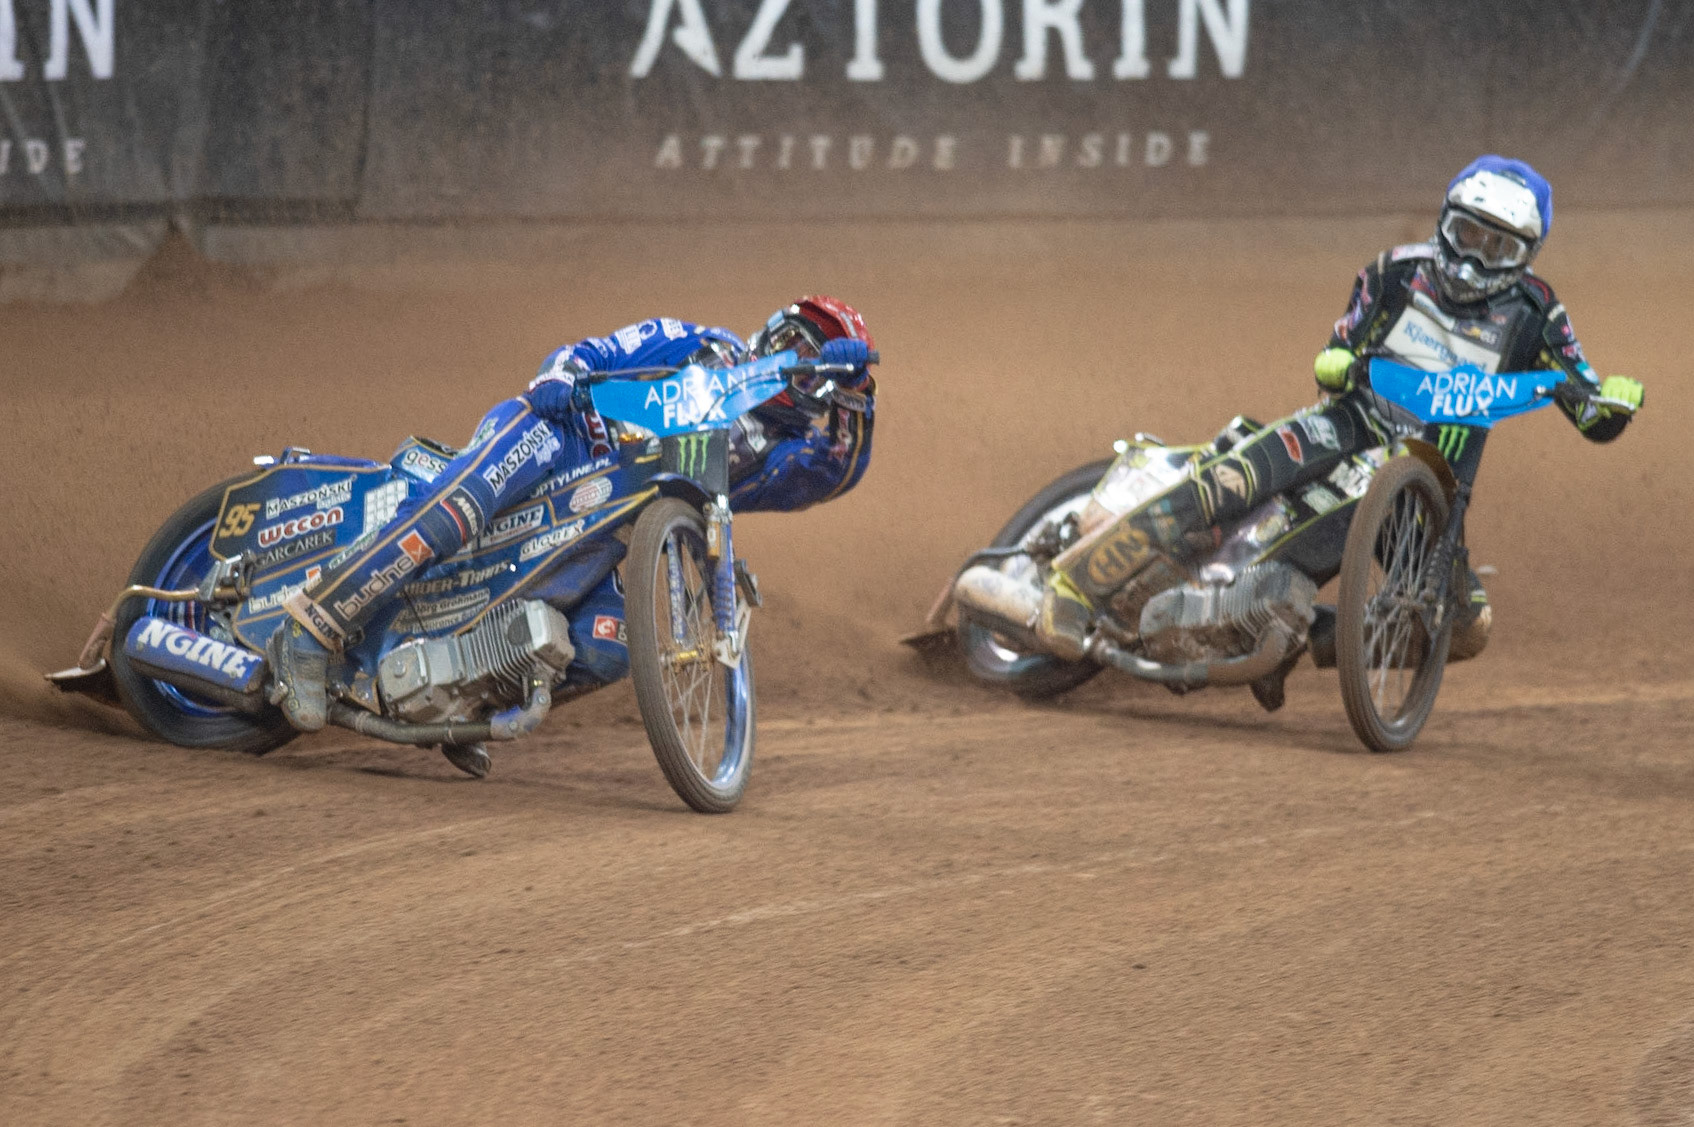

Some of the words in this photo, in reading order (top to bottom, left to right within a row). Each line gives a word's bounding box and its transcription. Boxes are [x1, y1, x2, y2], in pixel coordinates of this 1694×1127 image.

[655, 134, 957, 170] ATTITUDE
[1009, 131, 1211, 168] INSIDE
[644, 368, 747, 411] ADRAN
[1415, 371, 1518, 400] ADRIAN
[1430, 393, 1493, 418] FLUX
[403, 449, 448, 475] gess
[219, 503, 261, 539] 95
[304, 602, 342, 642] NGIN
[137, 617, 262, 679] NGINE
